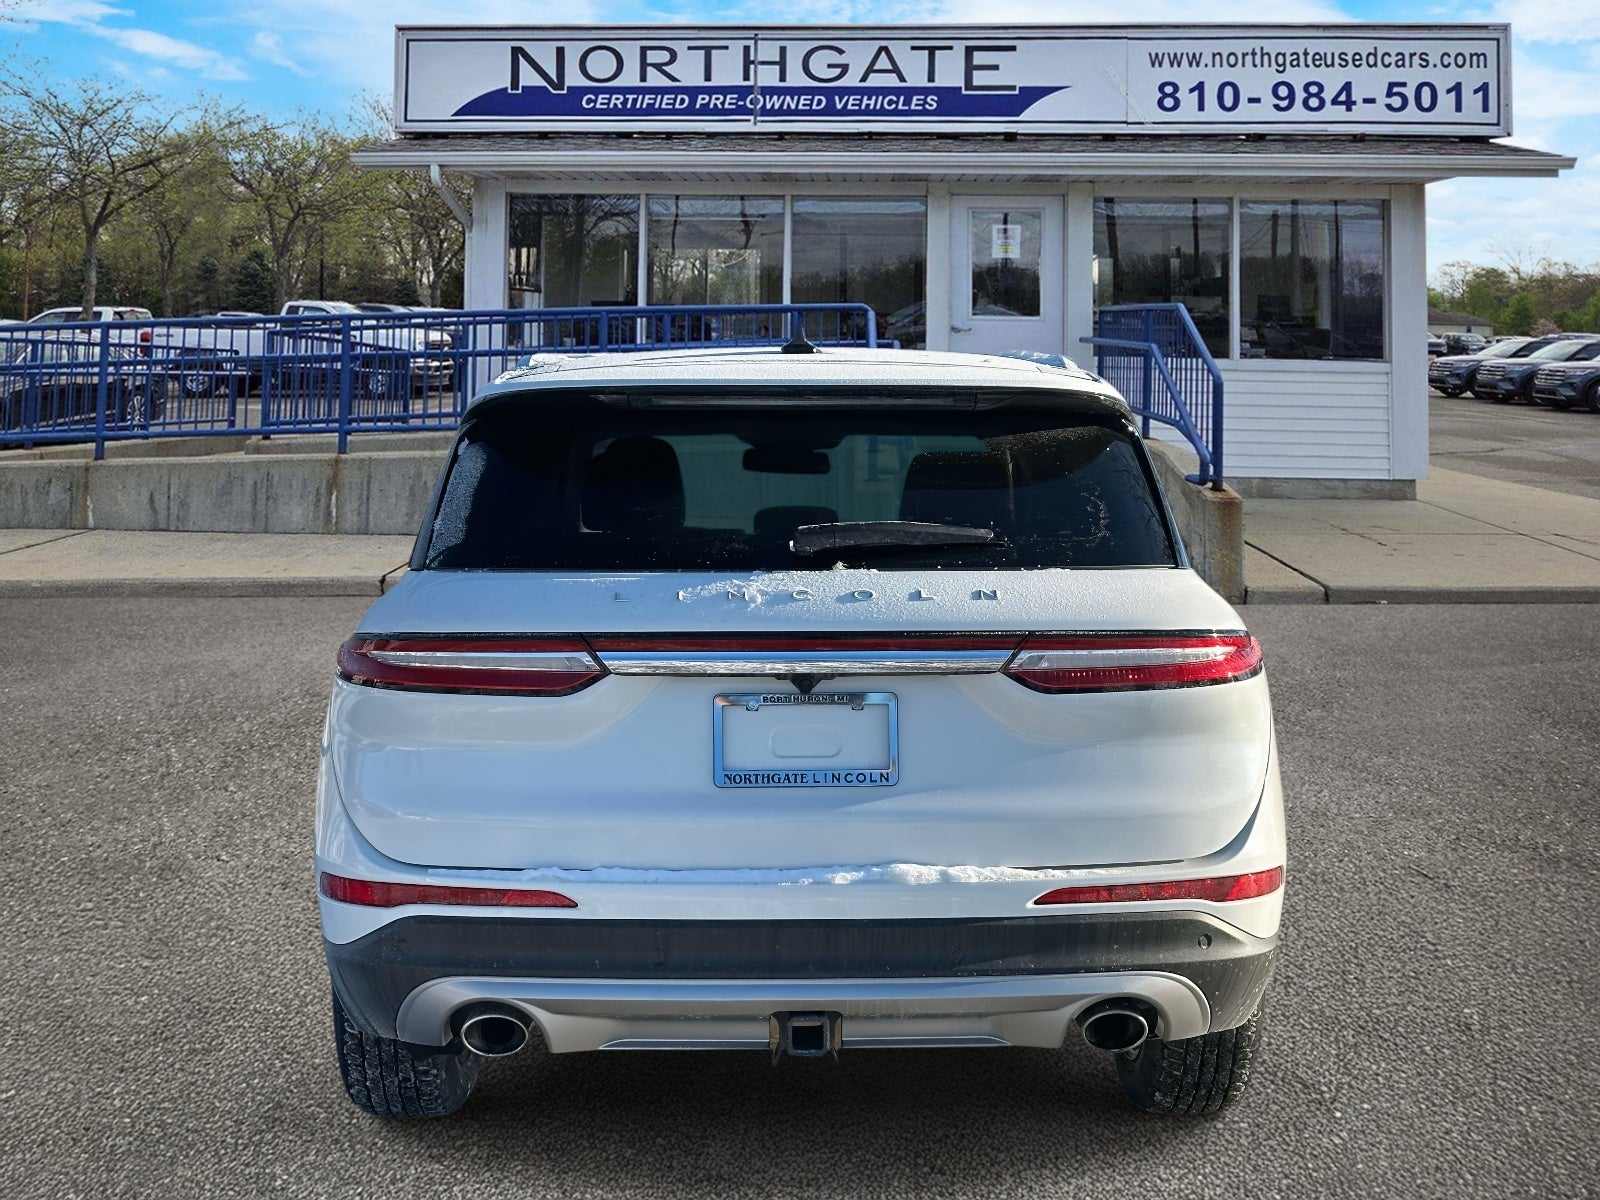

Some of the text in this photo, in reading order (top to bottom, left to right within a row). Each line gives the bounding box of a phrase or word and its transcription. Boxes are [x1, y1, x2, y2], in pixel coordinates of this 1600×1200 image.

[509, 45, 1018, 92] NORTHGATE
[1148, 47, 1488, 73] www.northgateusedcars.com
[580, 93, 939, 111] CERTIFIED PRE-OWNED VEHICLES
[1156, 81, 1491, 113] 810-984-5011
[762, 695, 790, 703] PORT
[835, 695, 849, 703] MI
[723, 772, 890, 785] NORTHGATE LINCOLN
